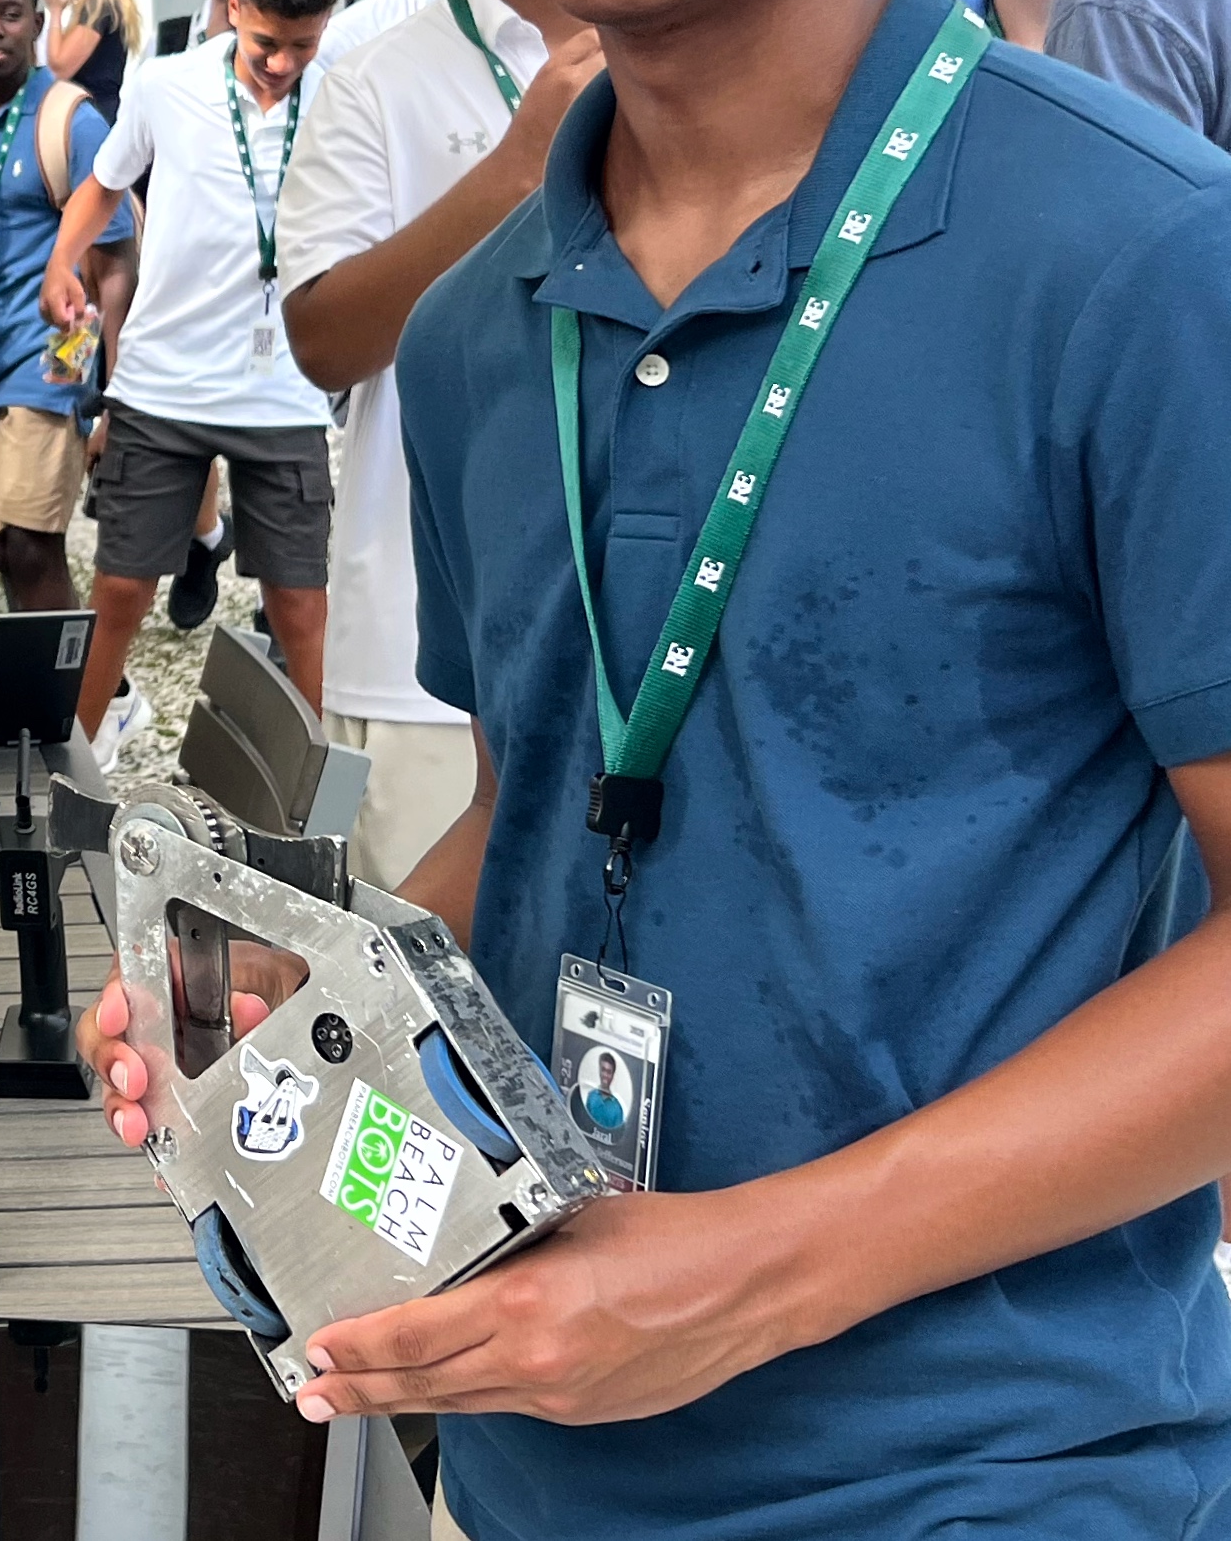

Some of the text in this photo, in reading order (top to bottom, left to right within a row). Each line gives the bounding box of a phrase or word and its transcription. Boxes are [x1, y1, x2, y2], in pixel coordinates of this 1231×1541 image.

[25, 872, 39, 915] RC4GS
[340, 1093, 407, 1223] BOTS
[378, 1119, 432, 1241] BEACH
[403, 1138, 456, 1253] PALM
